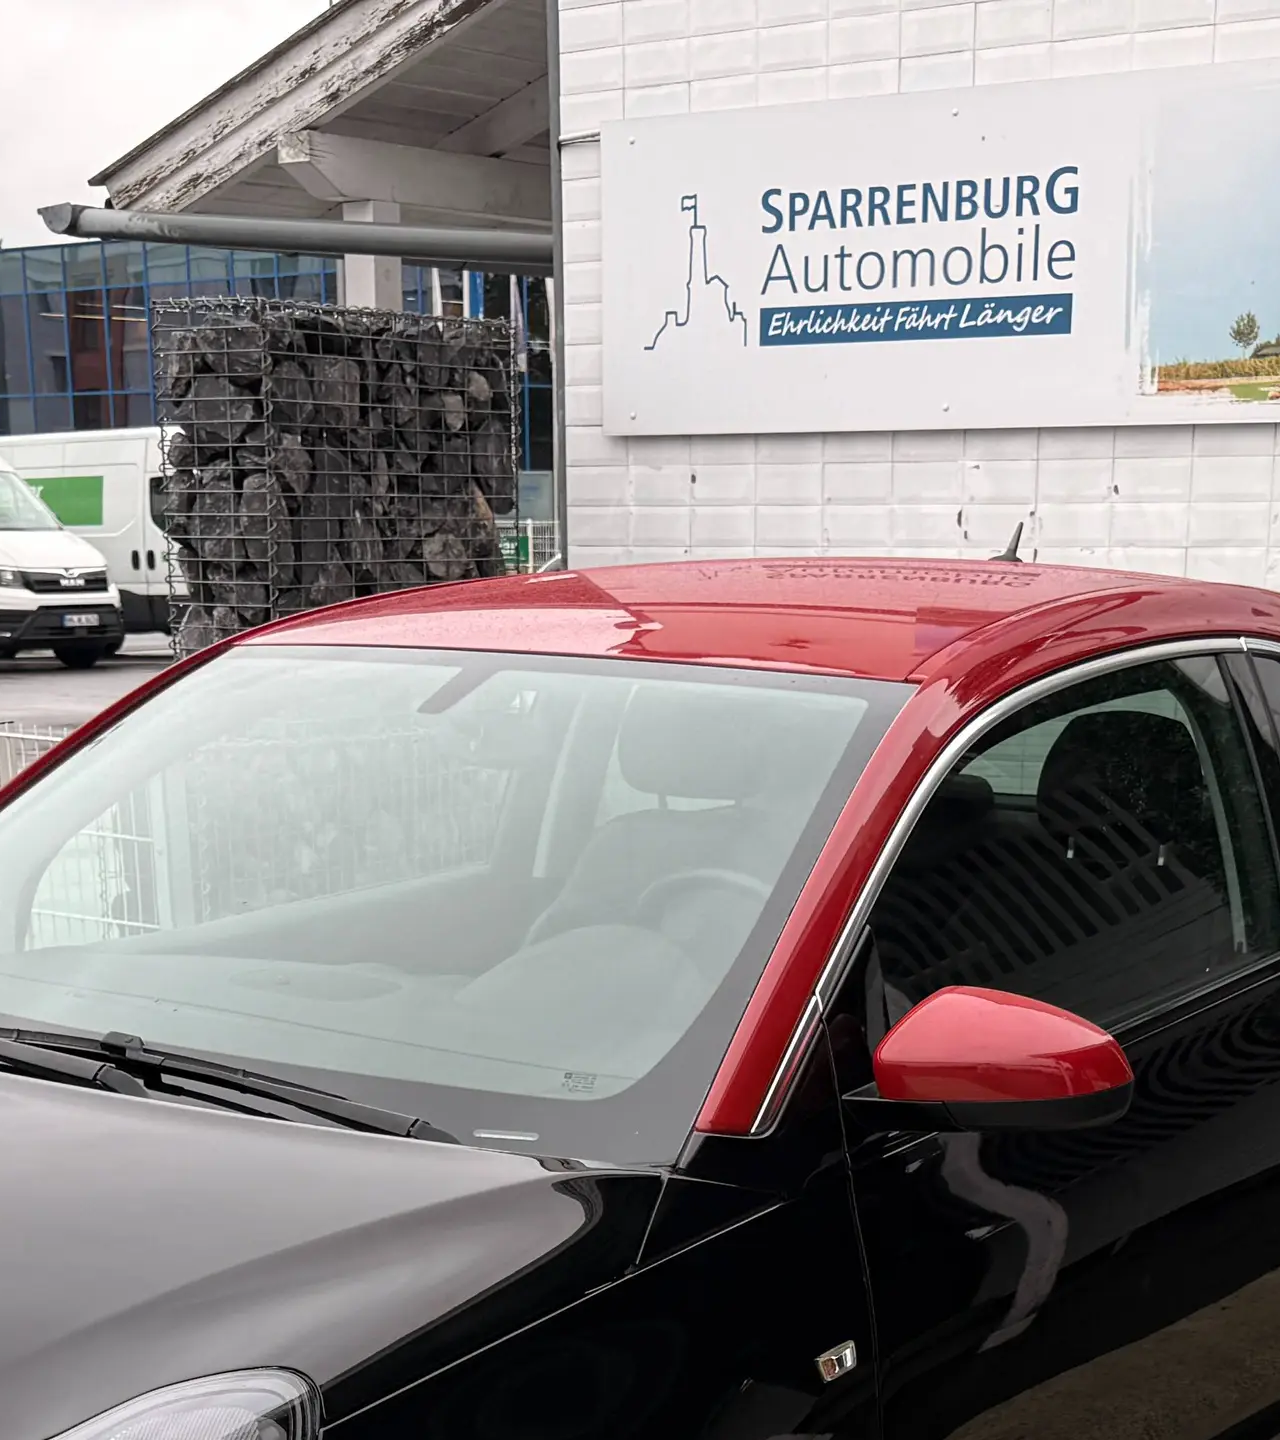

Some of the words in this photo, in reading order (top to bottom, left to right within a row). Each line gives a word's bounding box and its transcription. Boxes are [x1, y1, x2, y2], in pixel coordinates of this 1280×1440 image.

[759, 166, 1080, 234] SPARRENBURG
[760, 224, 1077, 296] Automobile
[767, 306, 894, 337] Ehrlichkeit
[893, 304, 959, 332] Fährt
[957, 303, 1064, 331] Länger
